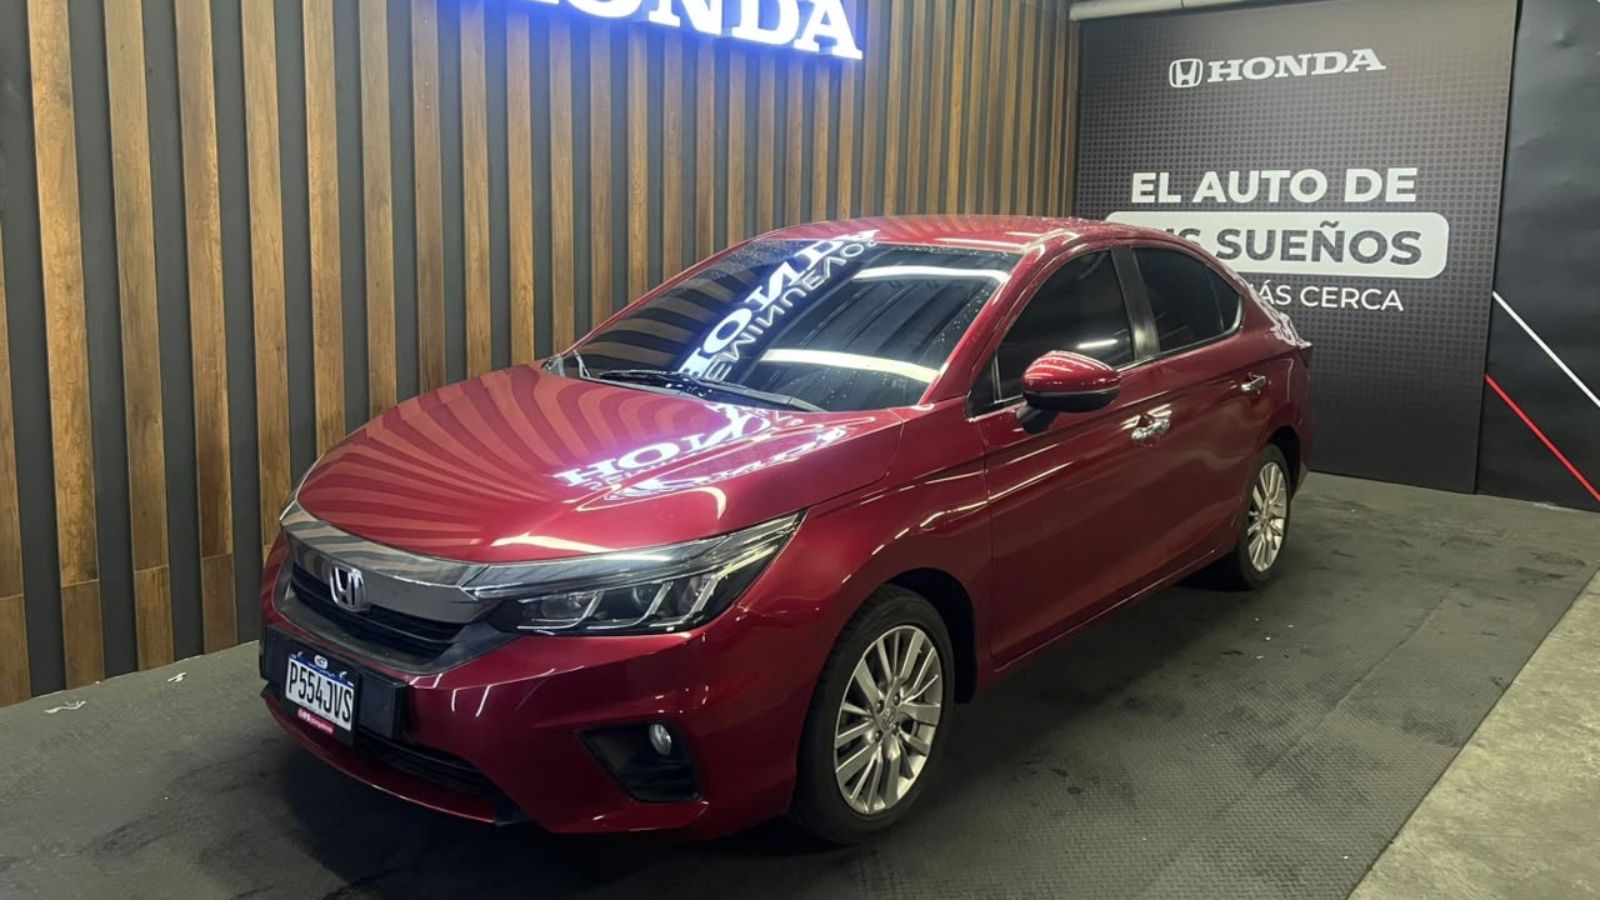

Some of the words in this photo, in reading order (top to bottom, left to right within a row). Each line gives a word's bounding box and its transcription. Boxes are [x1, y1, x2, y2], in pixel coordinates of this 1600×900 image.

[531, 0, 863, 59] NDA
[1207, 48, 1386, 82] HONDA
[1131, 172, 1182, 203] EL
[1192, 169, 1328, 203] AUTO
[1344, 167, 1418, 202] DE
[1216, 220, 1422, 265] SUEÑOS
[1250, 279, 1291, 306] ÁS
[1300, 286, 1404, 311] CERCA
[288, 660, 352, 723] P554JVS
